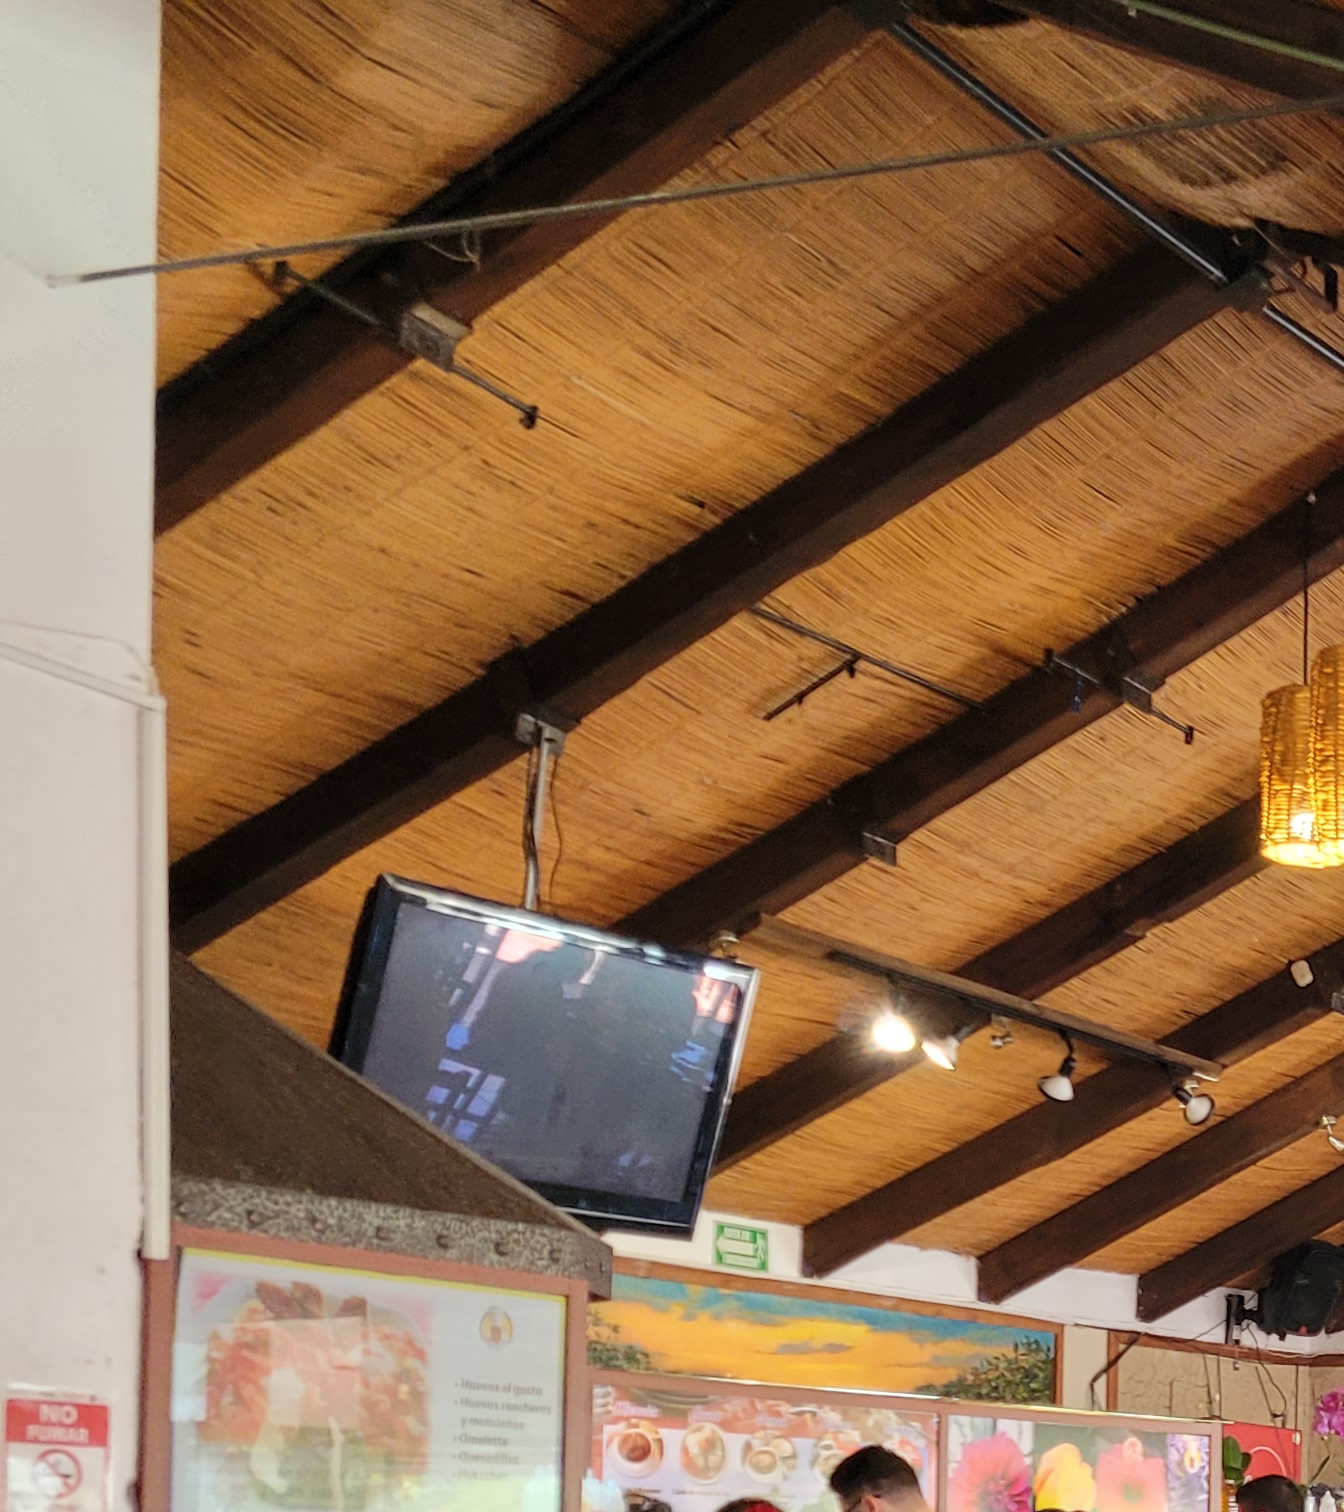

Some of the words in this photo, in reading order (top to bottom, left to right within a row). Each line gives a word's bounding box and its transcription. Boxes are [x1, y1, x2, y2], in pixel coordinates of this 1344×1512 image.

[460, 1378, 499, 1393] Huevos
[501, 1383, 512, 1393] al
[513, 1385, 543, 1397] gusto
[39, 1403, 78, 1425] NO
[460, 1397, 499, 1411] Huevos
[501, 1402, 552, 1415] rancheros
